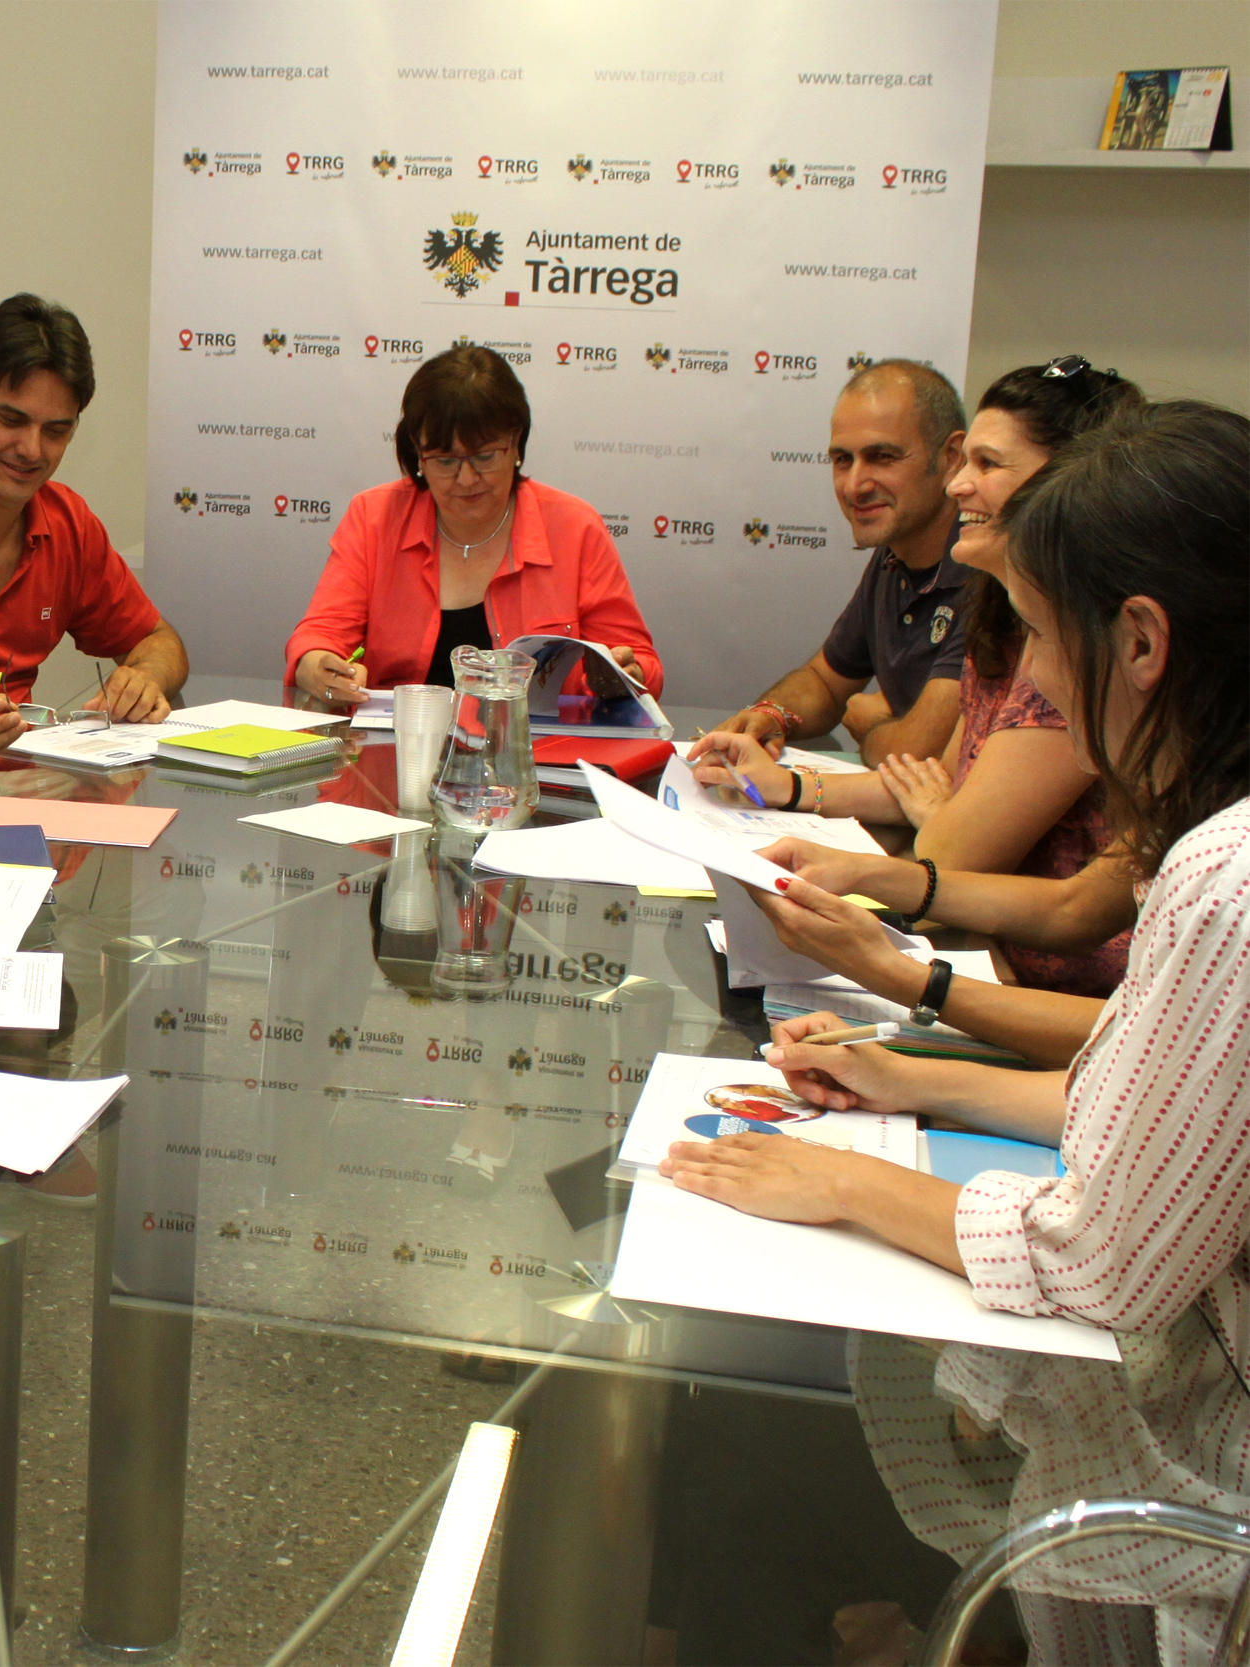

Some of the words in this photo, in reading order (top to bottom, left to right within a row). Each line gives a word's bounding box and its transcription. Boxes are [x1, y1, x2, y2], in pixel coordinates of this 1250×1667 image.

[207, 64, 330, 81] www.tarrega.cat
[397, 66, 524, 83] www.tarrega.cat
[594, 68, 725, 85] www.tarrega.cat
[797, 70, 934, 88] www.tarrega.cat
[214, 160, 262, 176] Tàrrega
[303, 155, 344, 170] TRRG
[495, 159, 538, 174] TRRG
[695, 163, 739, 178] TRRG
[404, 163, 453, 179] Tàrrega
[600, 167, 651, 183] Tàrrega
[901, 168, 948, 184] TRRG
[803, 172, 856, 189] Tàrrega
[526, 230, 648, 251] Ajuntament
[655, 232, 681, 251] de
[202, 244, 323, 261] www.tarrega.cat
[784, 262, 918, 281] www.tarrega.cat
[525, 256, 680, 304] Tàrrega
[195, 332, 236, 348] TRRG
[381, 339, 423, 354] TRRG
[293, 342, 340, 358] Tàrrega
[497, 350, 532, 365] rrega
[574, 346, 617, 361] TRRG
[678, 357, 728, 373] Tàrrega
[772, 355, 817, 371] TRRG
[197, 423, 316, 440] www.tarrega.cat
[573, 440, 700, 458] www.tarrega.cat
[204, 500, 251, 516] Tàrrega
[290, 499, 331, 514] TRRG
[671, 520, 715, 536] TRRG
[777, 532, 827, 549] Tàrrega
